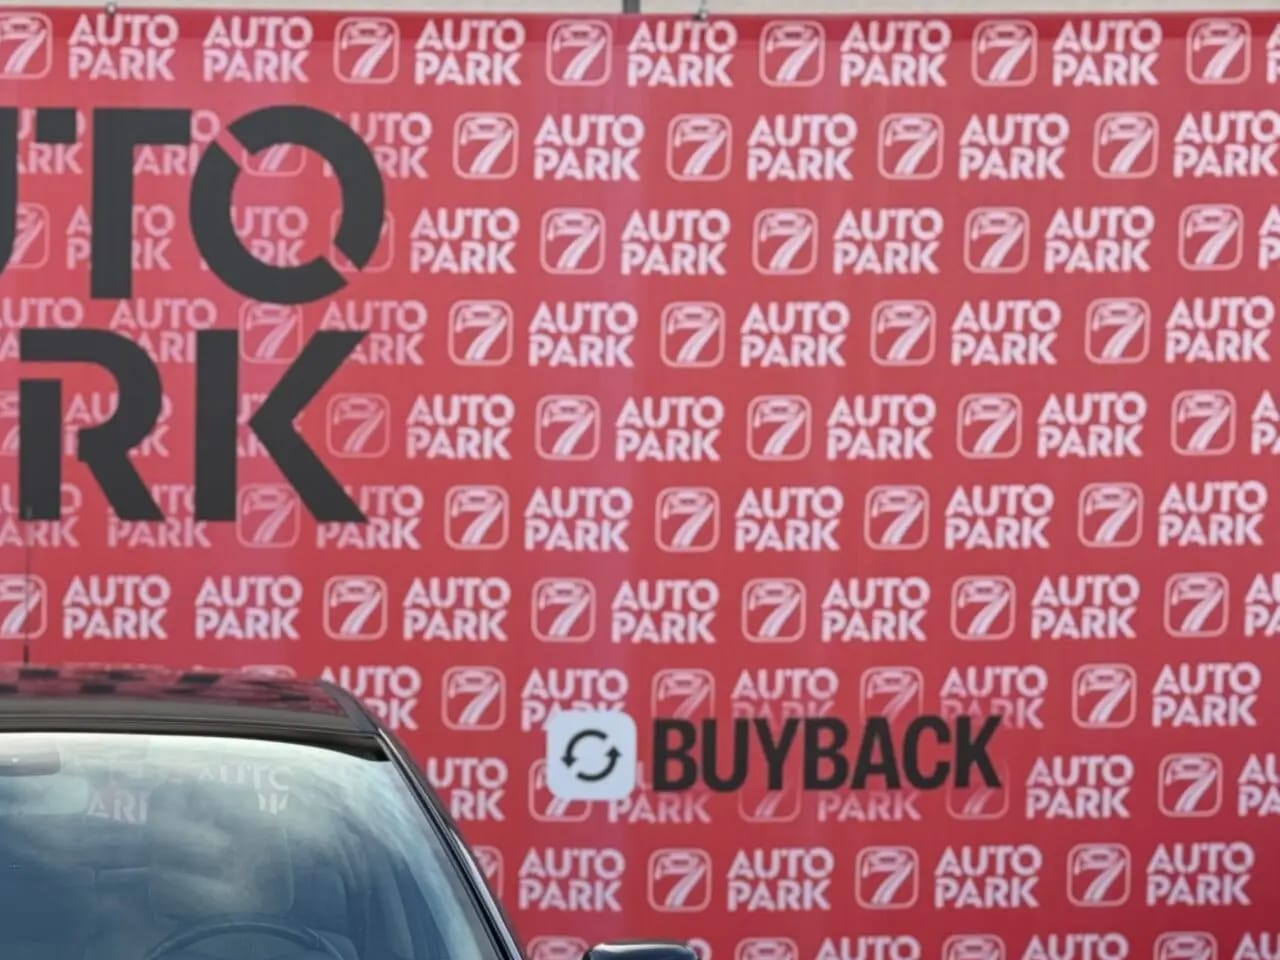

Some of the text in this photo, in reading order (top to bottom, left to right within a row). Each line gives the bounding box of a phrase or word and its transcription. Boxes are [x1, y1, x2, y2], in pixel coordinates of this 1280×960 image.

[70, 14, 175, 46] AUTO
[629, 21, 735, 52] AUTO
[1054, 20, 1160, 52] AUTO
[69, 47, 174, 80] PARK
[628, 54, 733, 87] PARK
[1053, 53, 1158, 86] PARK
[534, 114, 644, 146] AUTO
[959, 113, 1069, 146] AUTO
[1174, 110, 1280, 143] AUTO
[534, 147, 640, 181] PARK
[959, 147, 1065, 179] PARK
[1174, 144, 1279, 177] PARK
[410, 208, 519, 240] AUTO
[833, 208, 943, 240] AUTO
[1045, 206, 1155, 239] AUTO
[411, 241, 515, 273] PARK
[834, 241, 939, 274] PARK
[1045, 240, 1150, 272] PARK
[529, 302, 638, 333] AUTO
[741, 301, 850, 333] AUTO
[952, 299, 1061, 332] AUTO
[1166, 296, 1275, 329] AUTO
[529, 334, 634, 368] PARK
[741, 334, 846, 366] PARK
[951, 333, 1057, 365] PARK
[1166, 330, 1270, 362] PARK
[407, 394, 515, 426] AUTO
[827, 394, 936, 426] AUTO
[1038, 392, 1147, 424] AUTO
[407, 427, 511, 459] PARK
[827, 427, 932, 459] PARK
[1038, 425, 1143, 457] PARK
[735, 486, 843, 518] AUTO
[945, 484, 1054, 516] AUTO
[1159, 480, 1268, 513] AUTO
[736, 519, 840, 551] PARK
[945, 517, 1050, 549] PARK
[1158, 514, 1264, 546] PARK
[63, 576, 170, 606] AUTO
[195, 576, 302, 607] AUTO
[403, 577, 511, 608] AUTO
[611, 579, 719, 610] AUTO
[1031, 574, 1140, 606] AUTO
[64, 607, 167, 639] PARK
[195, 608, 298, 639] PARK
[404, 609, 507, 641] PARK
[612, 611, 715, 643] PARK
[1032, 607, 1136, 639] PARK
[1152, 662, 1261, 694] AUTO
[1152, 695, 1257, 726] PARK
[652, 715, 1002, 792] BUYBACK
[1026, 755, 1134, 786] AUTO
[1026, 787, 1130, 818] PARK
[519, 848, 625, 878] AUTO
[727, 847, 834, 879] AUTO
[934, 844, 1042, 876] AUTO
[1146, 842, 1255, 873] AUTO
[520, 879, 621, 911] PARK
[728, 880, 830, 910] PARK
[935, 877, 1039, 908] PARK
[1147, 874, 1250, 905] PARK
